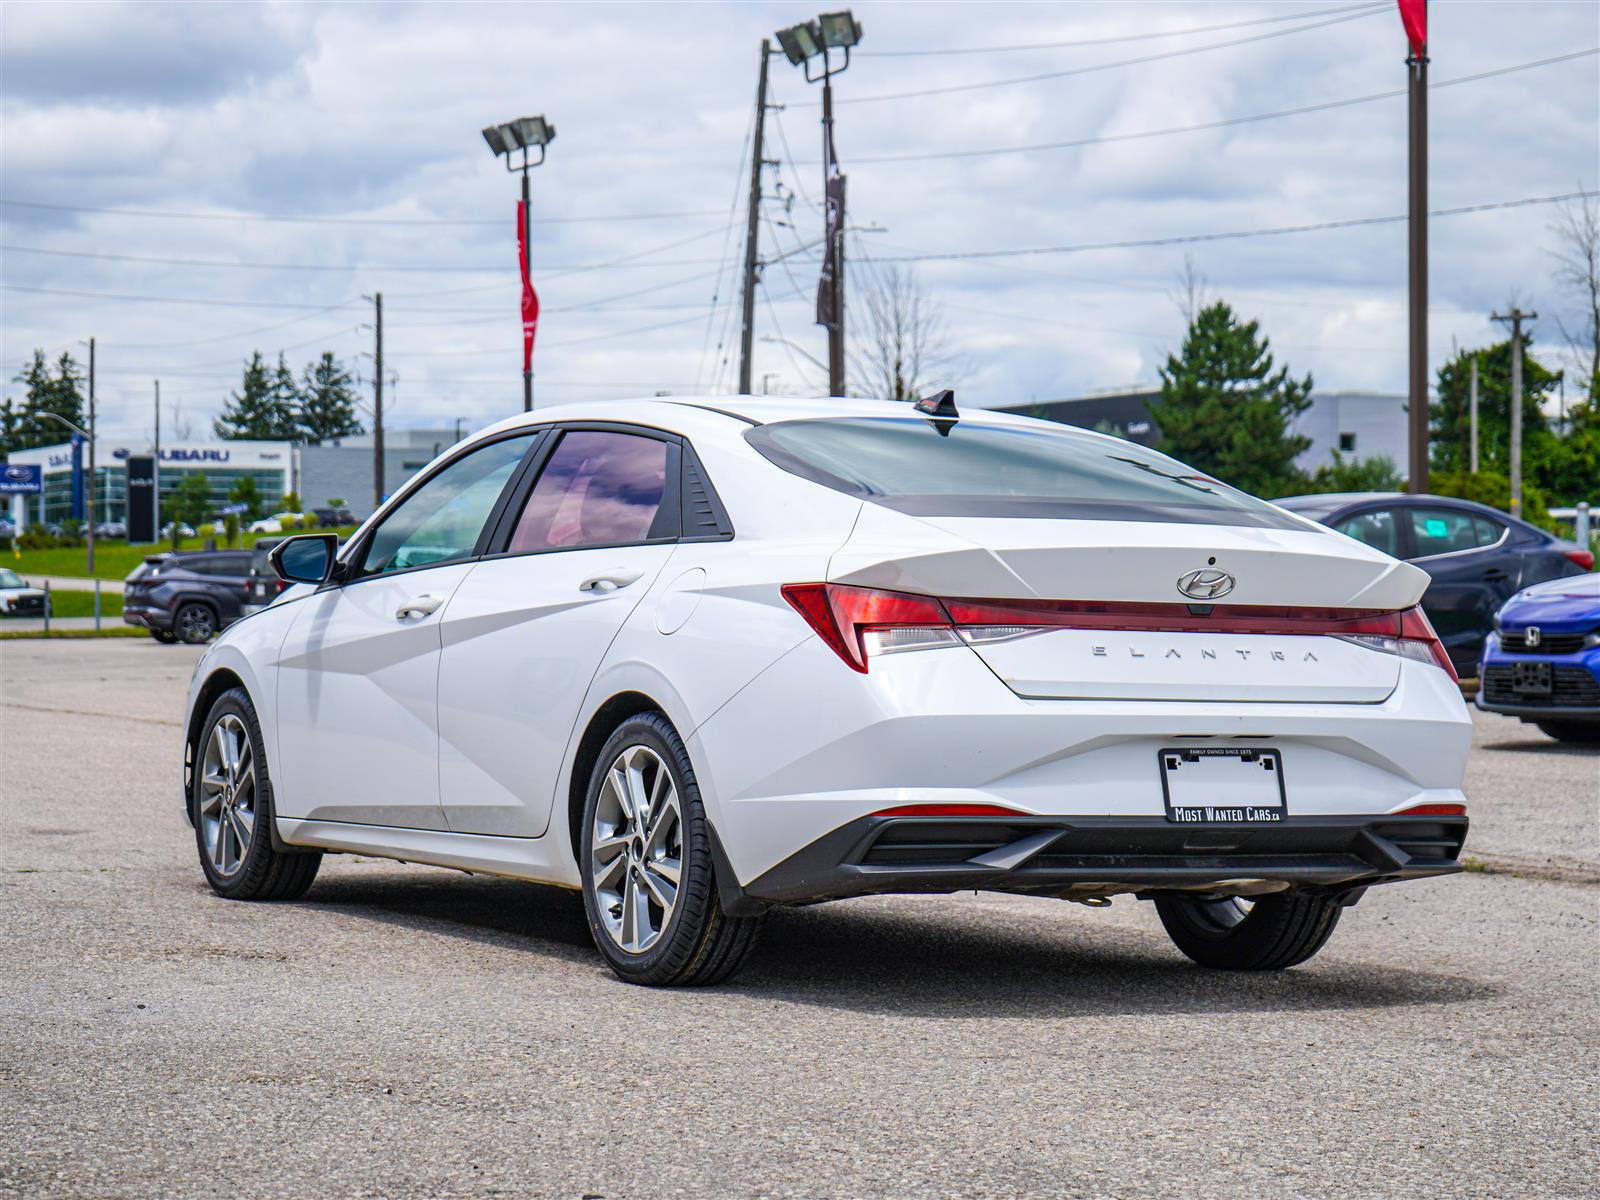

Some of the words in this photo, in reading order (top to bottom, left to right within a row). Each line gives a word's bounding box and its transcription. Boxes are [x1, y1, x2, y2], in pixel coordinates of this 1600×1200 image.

[159, 449, 230, 462] UBARU
[1091, 645, 1319, 663] ELANTRA
[1175, 807, 1202, 822] MOST
[1205, 807, 1243, 822] WANTED
